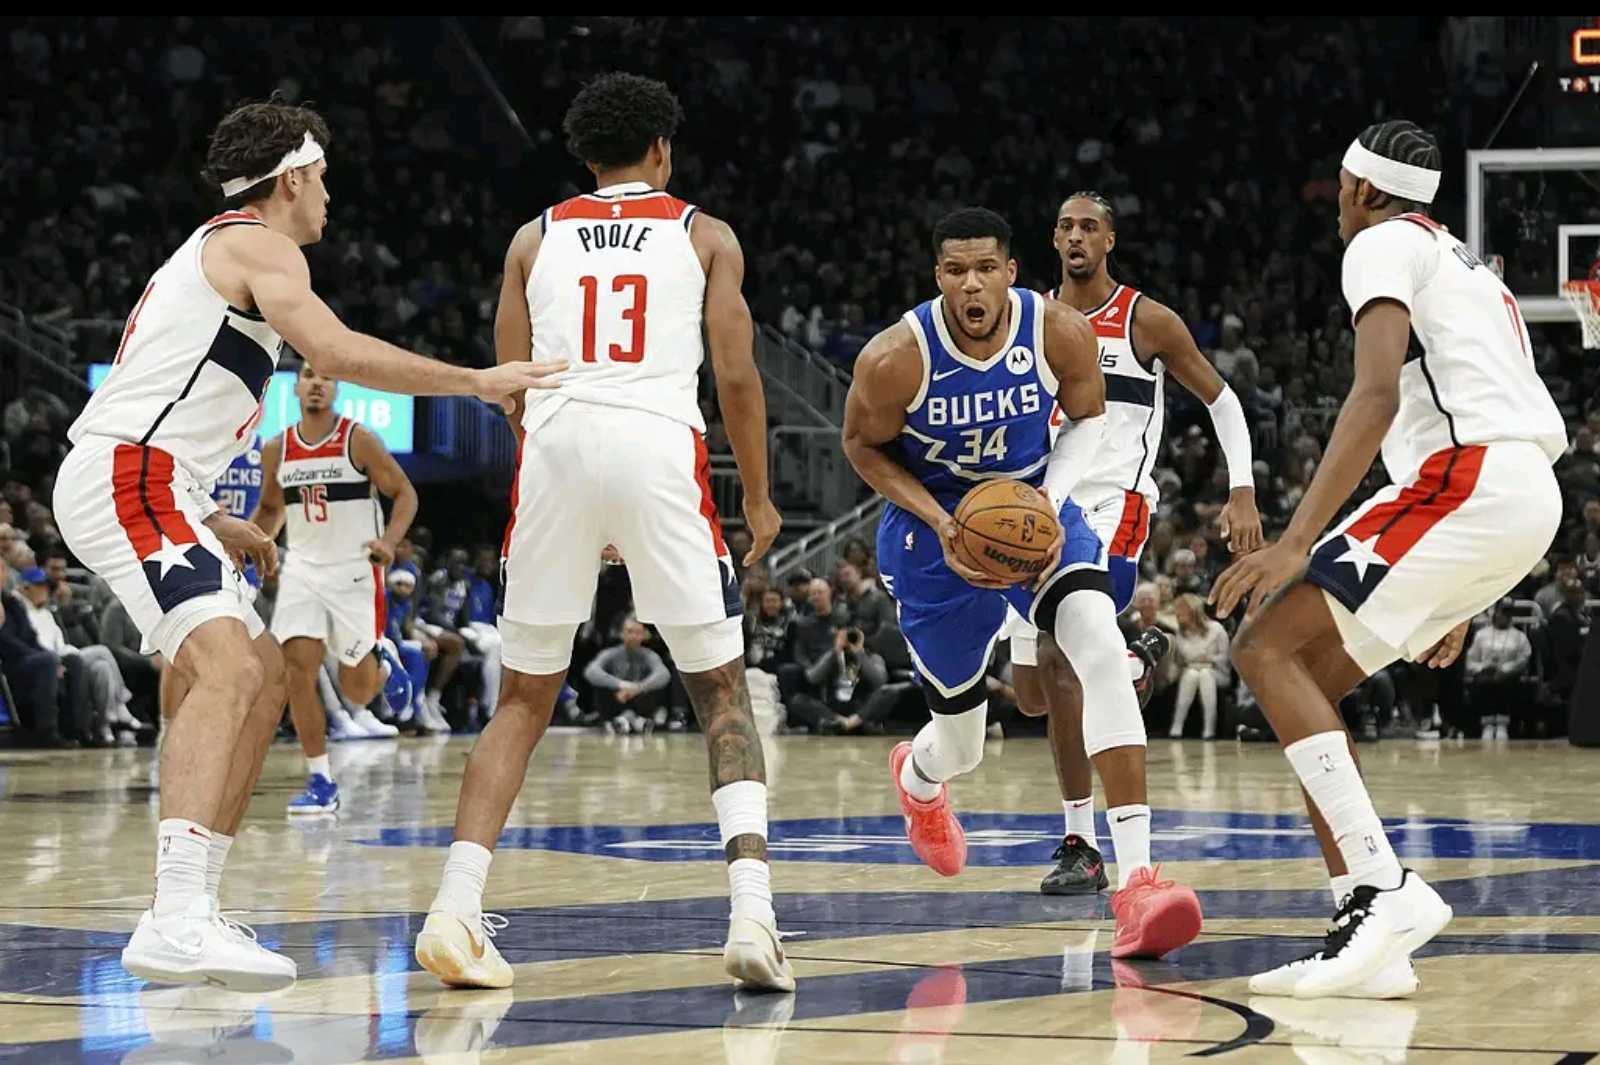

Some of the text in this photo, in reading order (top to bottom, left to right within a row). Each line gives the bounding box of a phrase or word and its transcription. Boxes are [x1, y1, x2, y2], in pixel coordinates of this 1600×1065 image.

[577, 223, 652, 252] POOLE
[579, 274, 648, 363] 13
[928, 383, 1040, 426] BUCKS
[957, 425, 1008, 464] 34
[216, 467, 262, 486] UCKS
[282, 463, 343, 483] wizards
[219, 489, 247, 515] 20
[301, 485, 328, 522] 15
